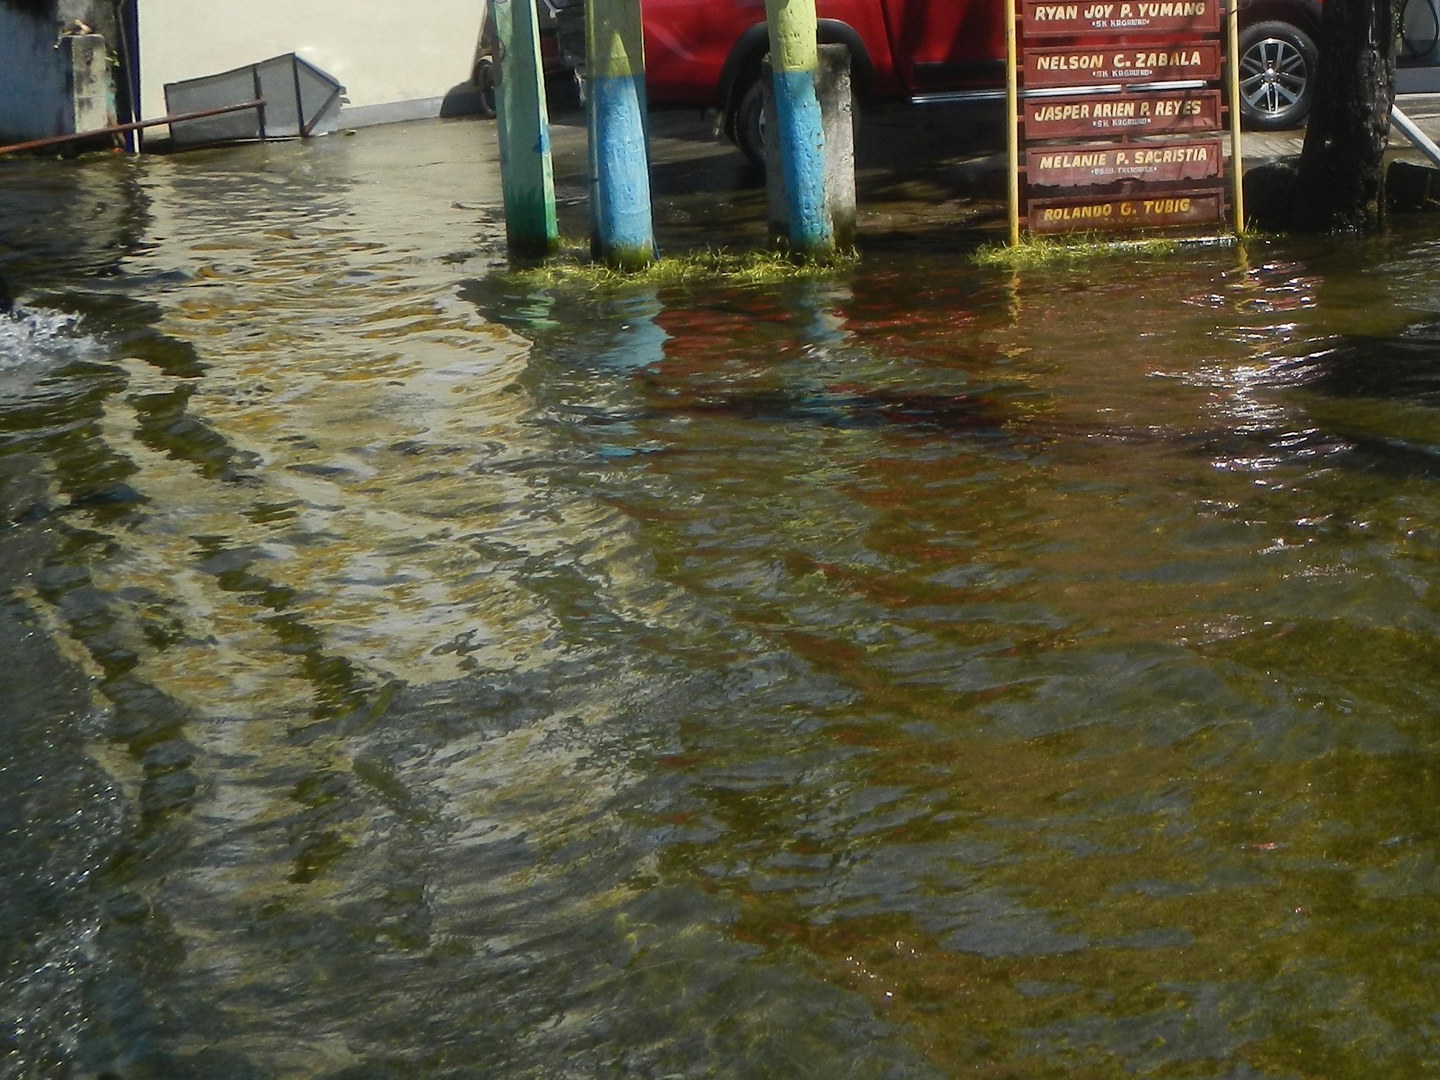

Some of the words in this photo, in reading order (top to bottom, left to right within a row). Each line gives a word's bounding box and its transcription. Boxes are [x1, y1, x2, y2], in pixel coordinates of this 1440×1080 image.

[1034, 5, 1078, 21] RYAN
[1084, 4, 1115, 19] JOY
[1120, 4, 1133, 19] P.
[1137, 2, 1206, 17] YUMANG
[1037, 54, 1104, 71] NELSON
[1113, 52, 1132, 69] C.
[1135, 51, 1202, 69] ZABALA
[1034, 103, 1090, 122] JASPER
[1092, 101, 1135, 119] ARIEN
[1140, 101, 1151, 117] P.
[1155, 99, 1202, 117] REYES
[1039, 152, 1107, 170] MELANIE
[1115, 151, 1130, 167] P.
[1134, 147, 1208, 166] SACRISTIA
[1043, 202, 1113, 221] ROLANDO
[1119, 200, 1137, 217] G.
[1143, 198, 1191, 215] TUBIG
